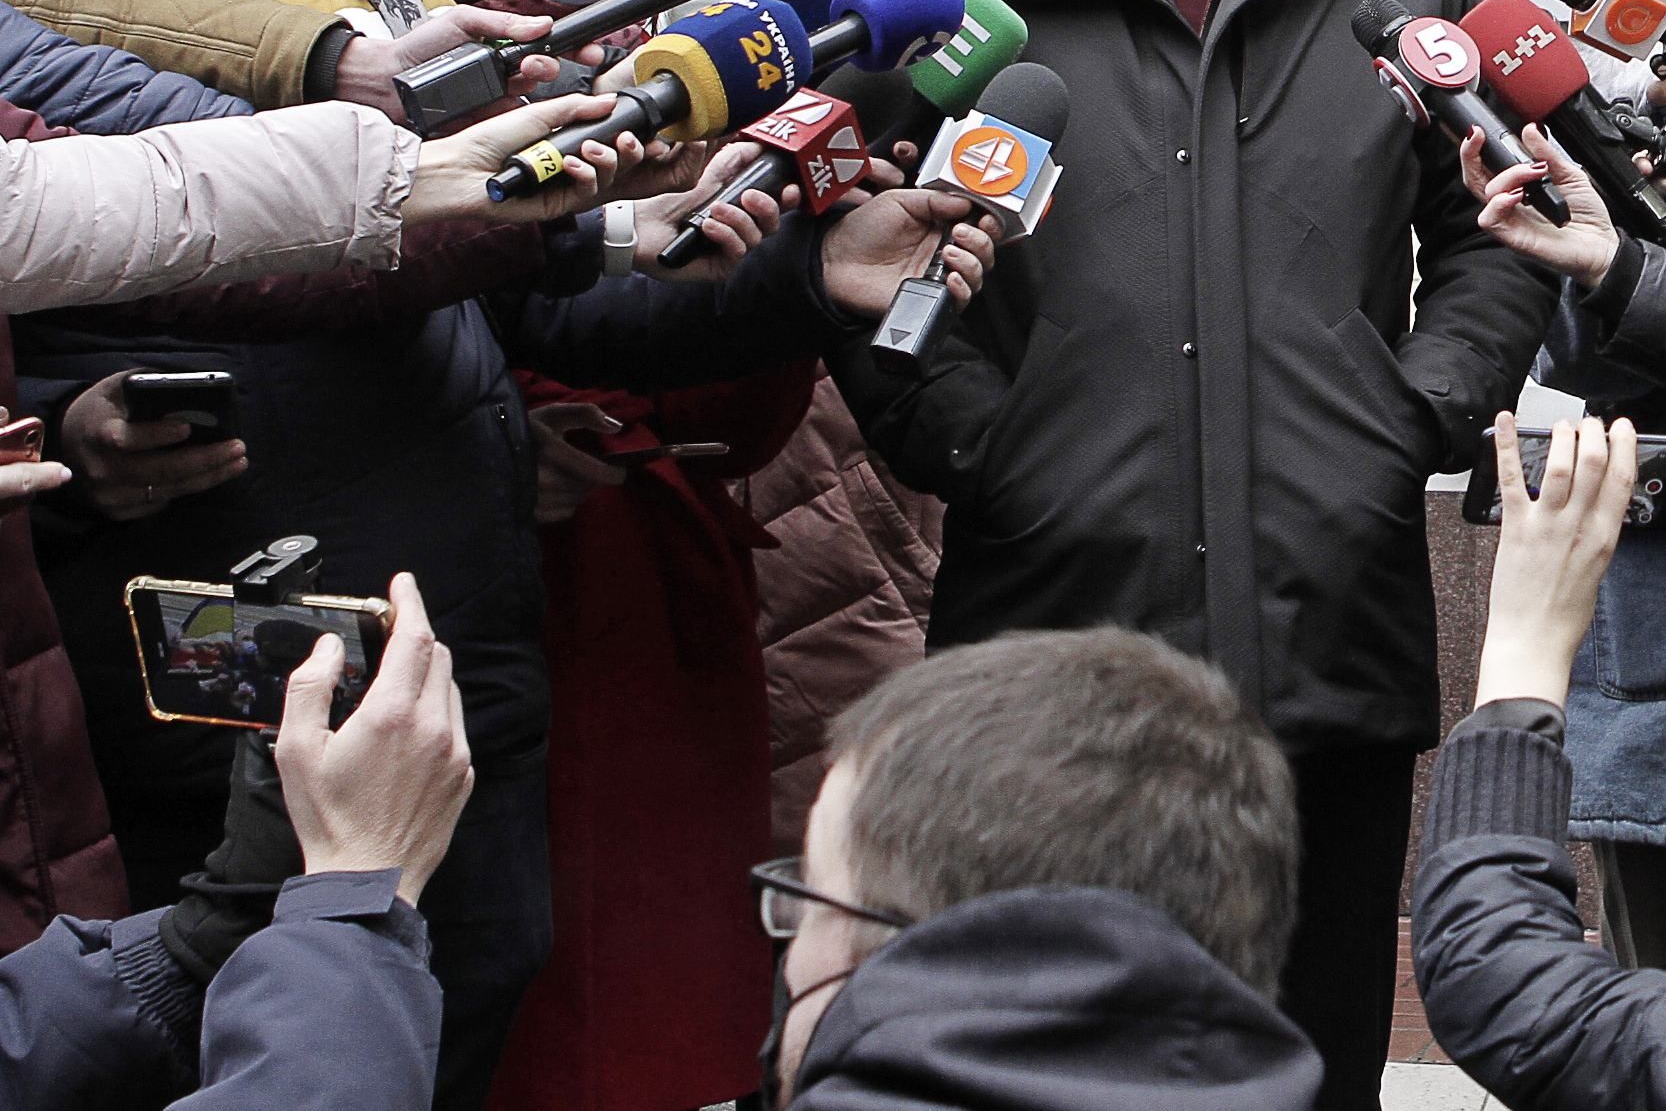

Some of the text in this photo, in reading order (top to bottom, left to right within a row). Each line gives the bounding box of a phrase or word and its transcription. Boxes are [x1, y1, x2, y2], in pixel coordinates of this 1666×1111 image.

[738, 30, 783, 91] 24
[759, 10, 796, 94] УКРАЇНА
[1415, 22, 1468, 77] 5
[1492, 24, 1557, 76] 1+1
[756, 117, 798, 142] zik
[807, 154, 833, 199] zik
